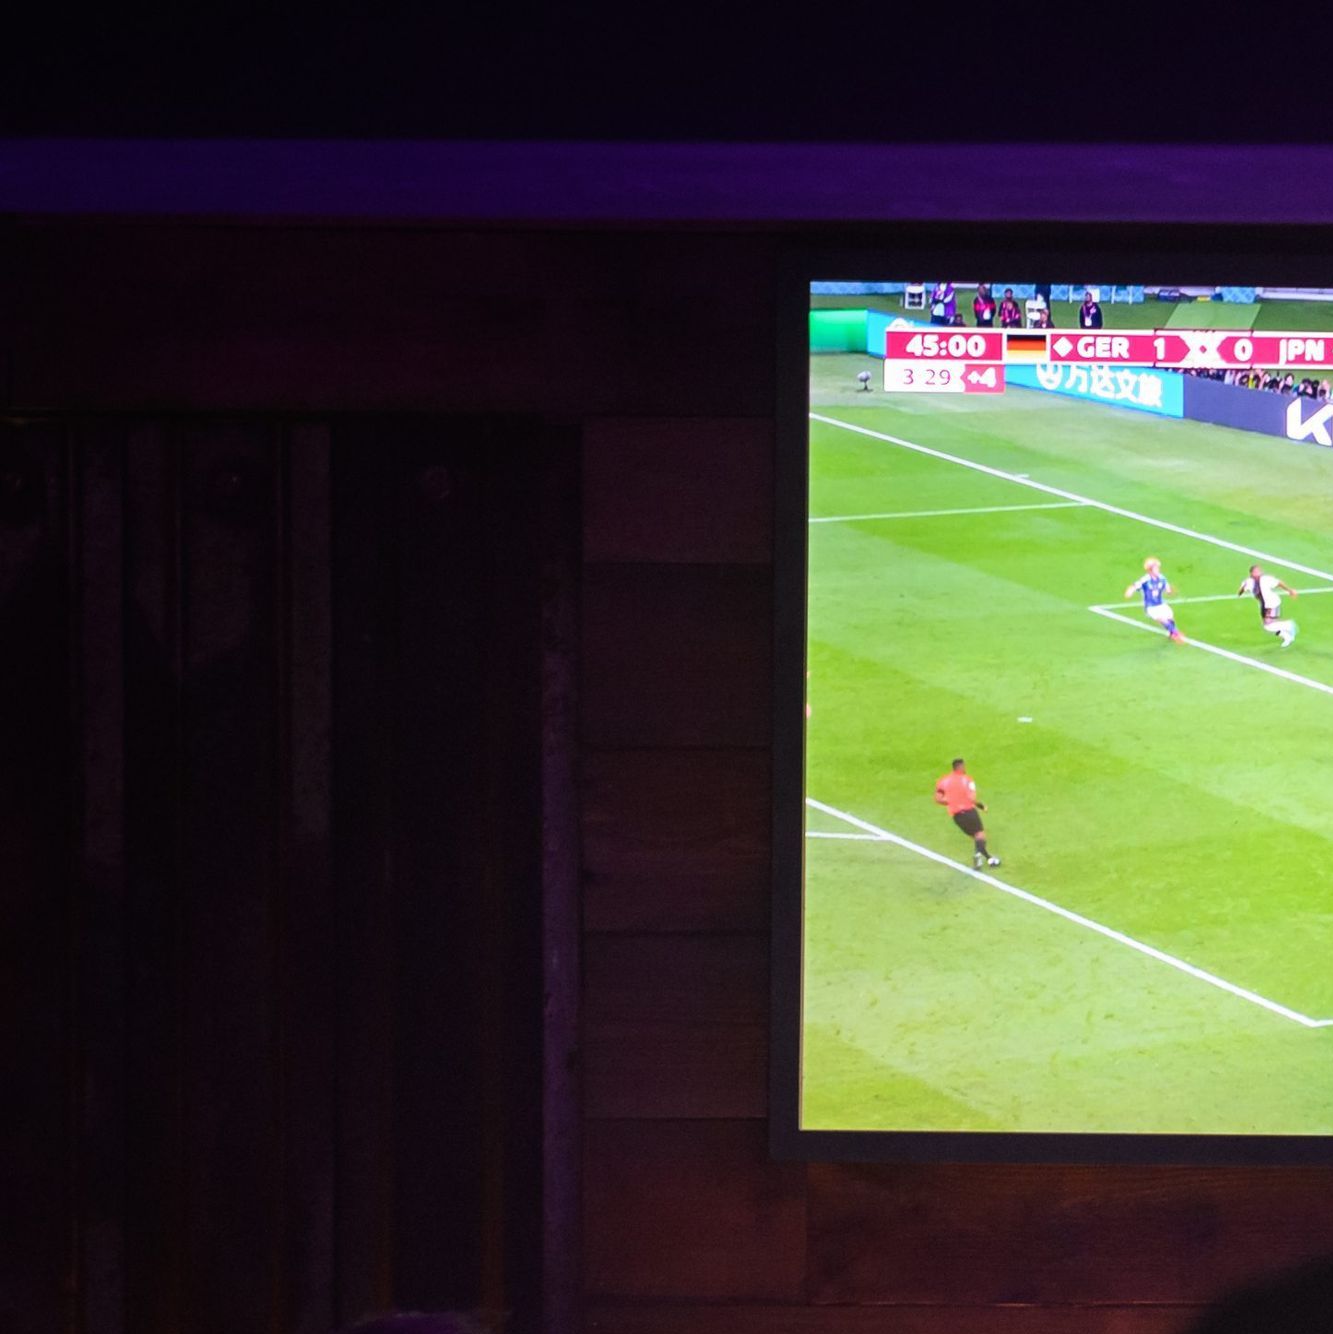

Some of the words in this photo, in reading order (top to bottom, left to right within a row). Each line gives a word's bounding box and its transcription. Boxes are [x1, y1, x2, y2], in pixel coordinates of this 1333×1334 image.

[905, 333, 987, 358] 45:00
[1077, 337, 1130, 360] GER
[1153, 338, 1167, 360] 1
[1234, 339, 1254, 362] 0
[1279, 338, 1325, 364] JPN
[967, 366, 997, 388] +4
